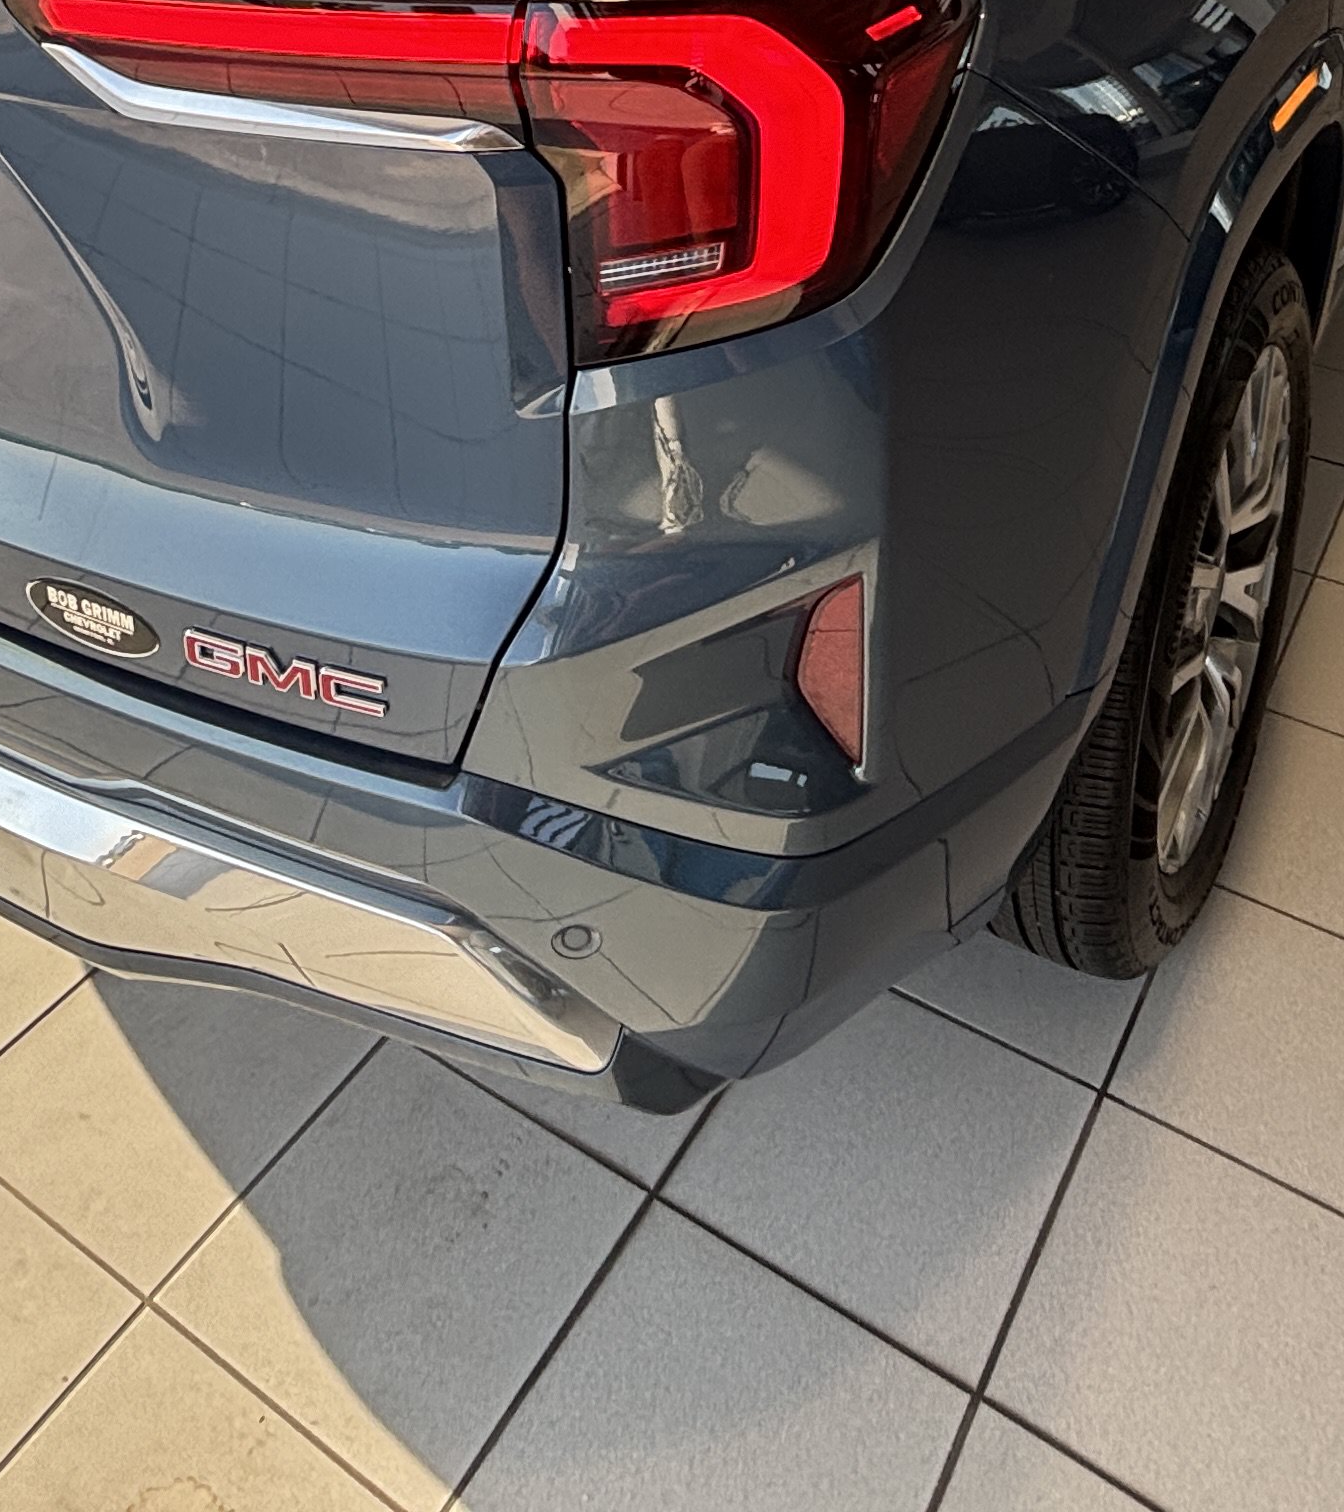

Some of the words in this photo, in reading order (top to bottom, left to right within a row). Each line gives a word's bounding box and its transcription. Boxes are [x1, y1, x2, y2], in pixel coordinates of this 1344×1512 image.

[46, 585, 79, 611] BOB
[80, 598, 135, 632] GRIMM
[63, 610, 122, 642] CHEVROLET
[183, 625, 388, 718] GMC
